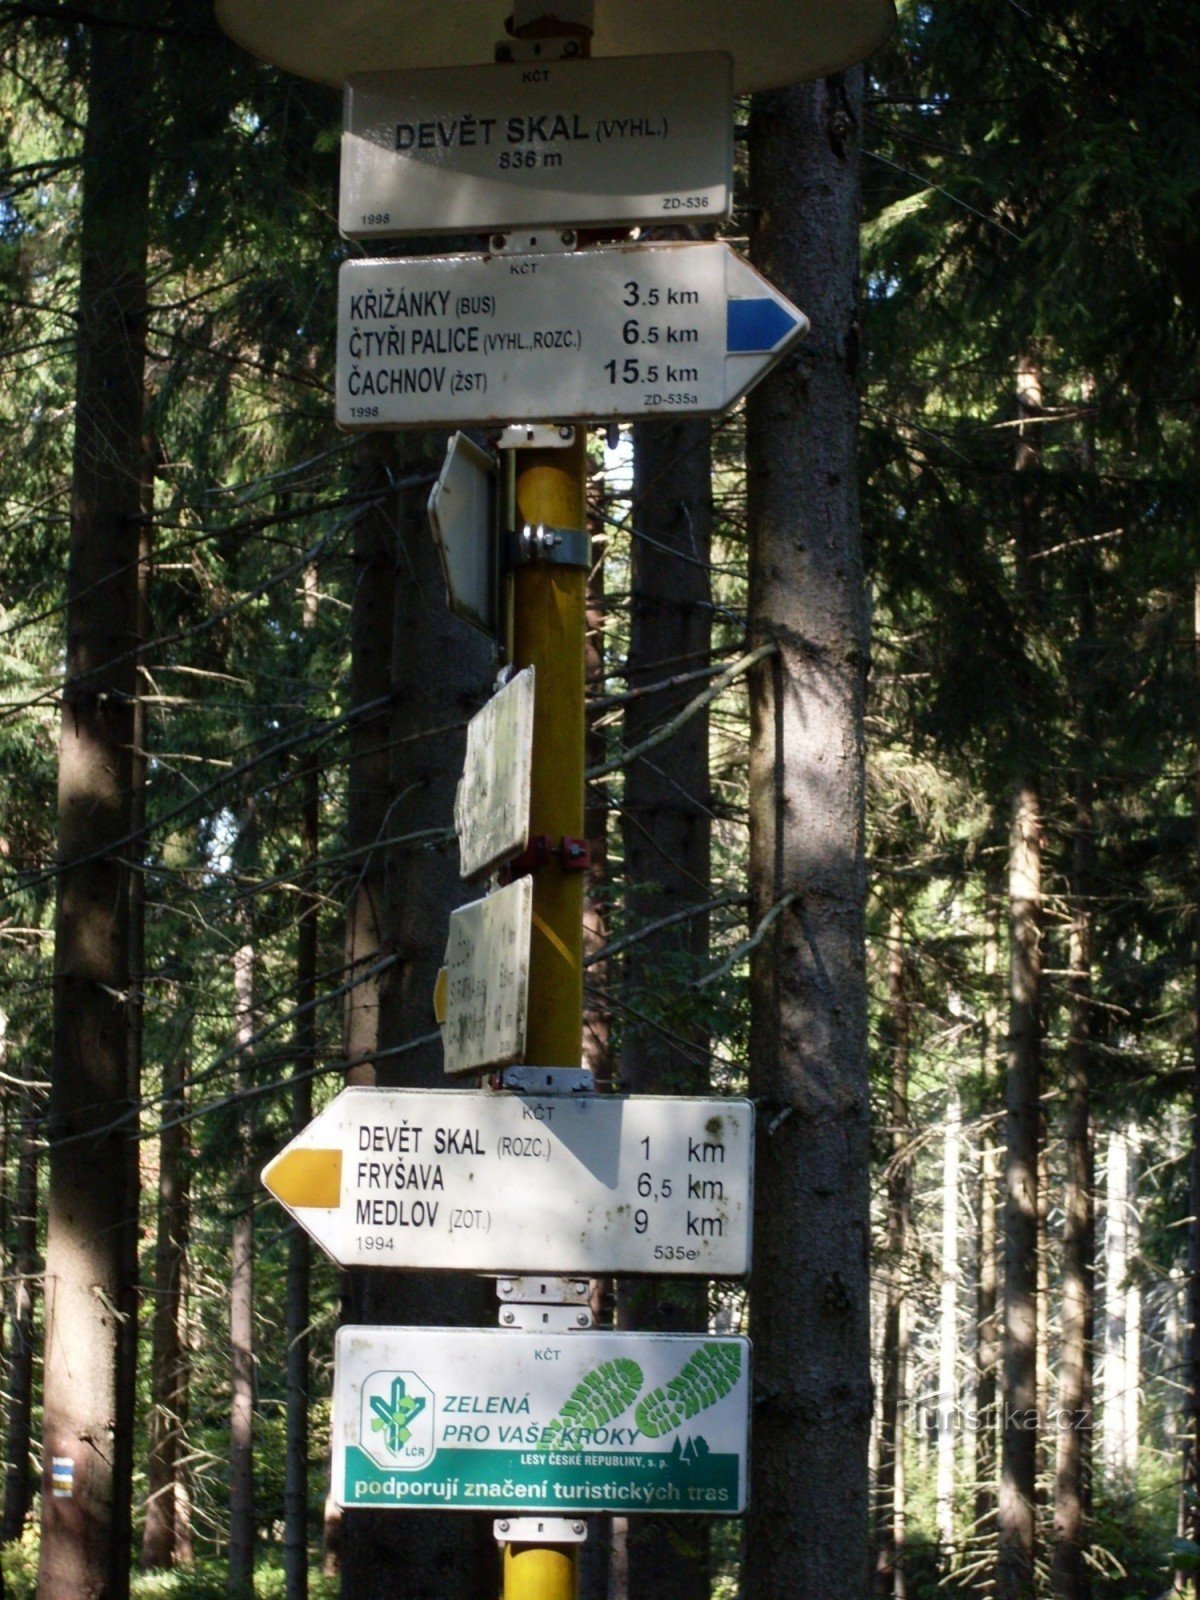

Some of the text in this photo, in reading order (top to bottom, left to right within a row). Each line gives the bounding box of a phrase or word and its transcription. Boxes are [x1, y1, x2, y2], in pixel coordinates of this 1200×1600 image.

[522, 69, 549, 82] KČT
[395, 114, 668, 150] DEVĚT SKAL (VYHL.)
[499, 151, 562, 169] 836 m
[663, 197, 709, 210] ZD-536
[361, 213, 390, 225] 1998
[510, 263, 538, 274] KČT
[350, 287, 495, 320] KŘIŽÁNKY (BUS)
[623, 281, 699, 307] 3.5 km
[350, 325, 405, 358] ČTYŘI
[412, 327, 479, 354] PALICE
[622, 319, 698, 345] 6.5 km
[349, 365, 446, 396] ČACHNOV
[604, 359, 698, 384] 15.5 km
[644, 394, 698, 405] ZD-535a
[350, 407, 379, 417] 1998
[523, 1105, 555, 1120] KČT
[359, 1119, 551, 1162] DEVĚT SKAL (ROZC.)
[640, 1136, 725, 1163] 1 km
[357, 1157, 445, 1191] FRYŠAVA
[637, 1172, 723, 1202] 6,5 km
[355, 1200, 491, 1233] MEDLOV (ZOT.)
[634, 1209, 723, 1236] 9 km
[355, 1236, 394, 1250] 1994
[653, 1246, 696, 1261] 535e
[534, 1348, 562, 1360] KČT
[443, 1393, 530, 1414] ZELENÁ
[443, 1421, 641, 1445] PRO VAŠE KROKY
[521, 1454, 545, 1465] LESY
[549, 1452, 582, 1466] ČESKÉ
[584, 1455, 645, 1469] REPUBLIKY,
[355, 1477, 729, 1503] podporují značení turistických tras
